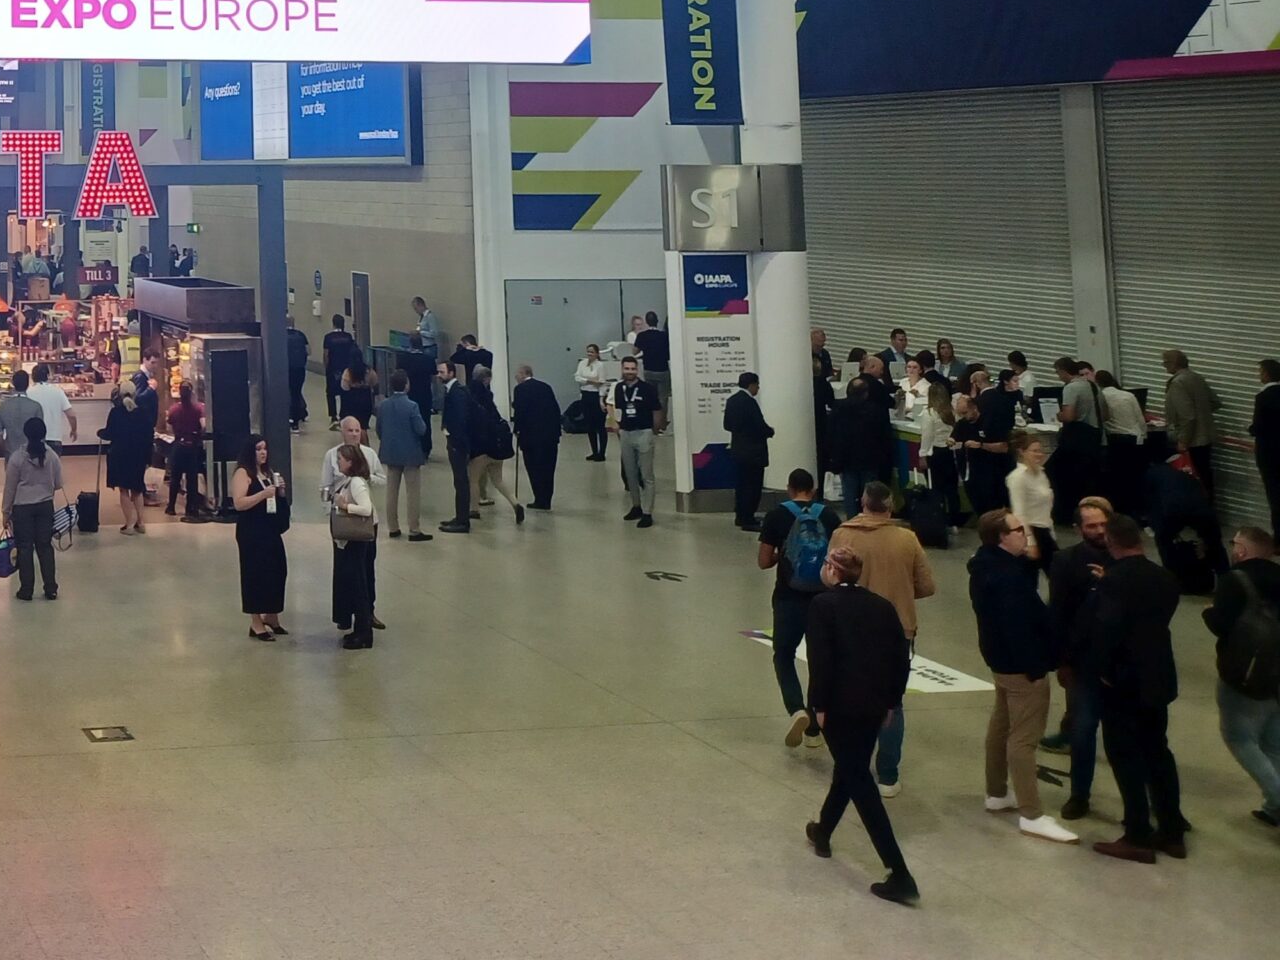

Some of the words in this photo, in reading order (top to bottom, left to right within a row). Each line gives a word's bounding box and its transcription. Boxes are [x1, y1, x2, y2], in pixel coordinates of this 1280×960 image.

[204, 86, 214, 100] Any
[215, 82, 240, 100] questions?
[301, 85, 311, 98] you
[312, 82, 322, 97] get
[322, 80, 332, 94] the
[332, 79, 346, 92] best
[346, 77, 357, 90] out
[357, 74, 365, 89] of
[301, 104, 314, 117] your
[690, 188, 739, 230] S1
[85, 270, 104, 281] TILL
[106, 270, 112, 281] 3
[705, 274, 733, 284] IAAPA
